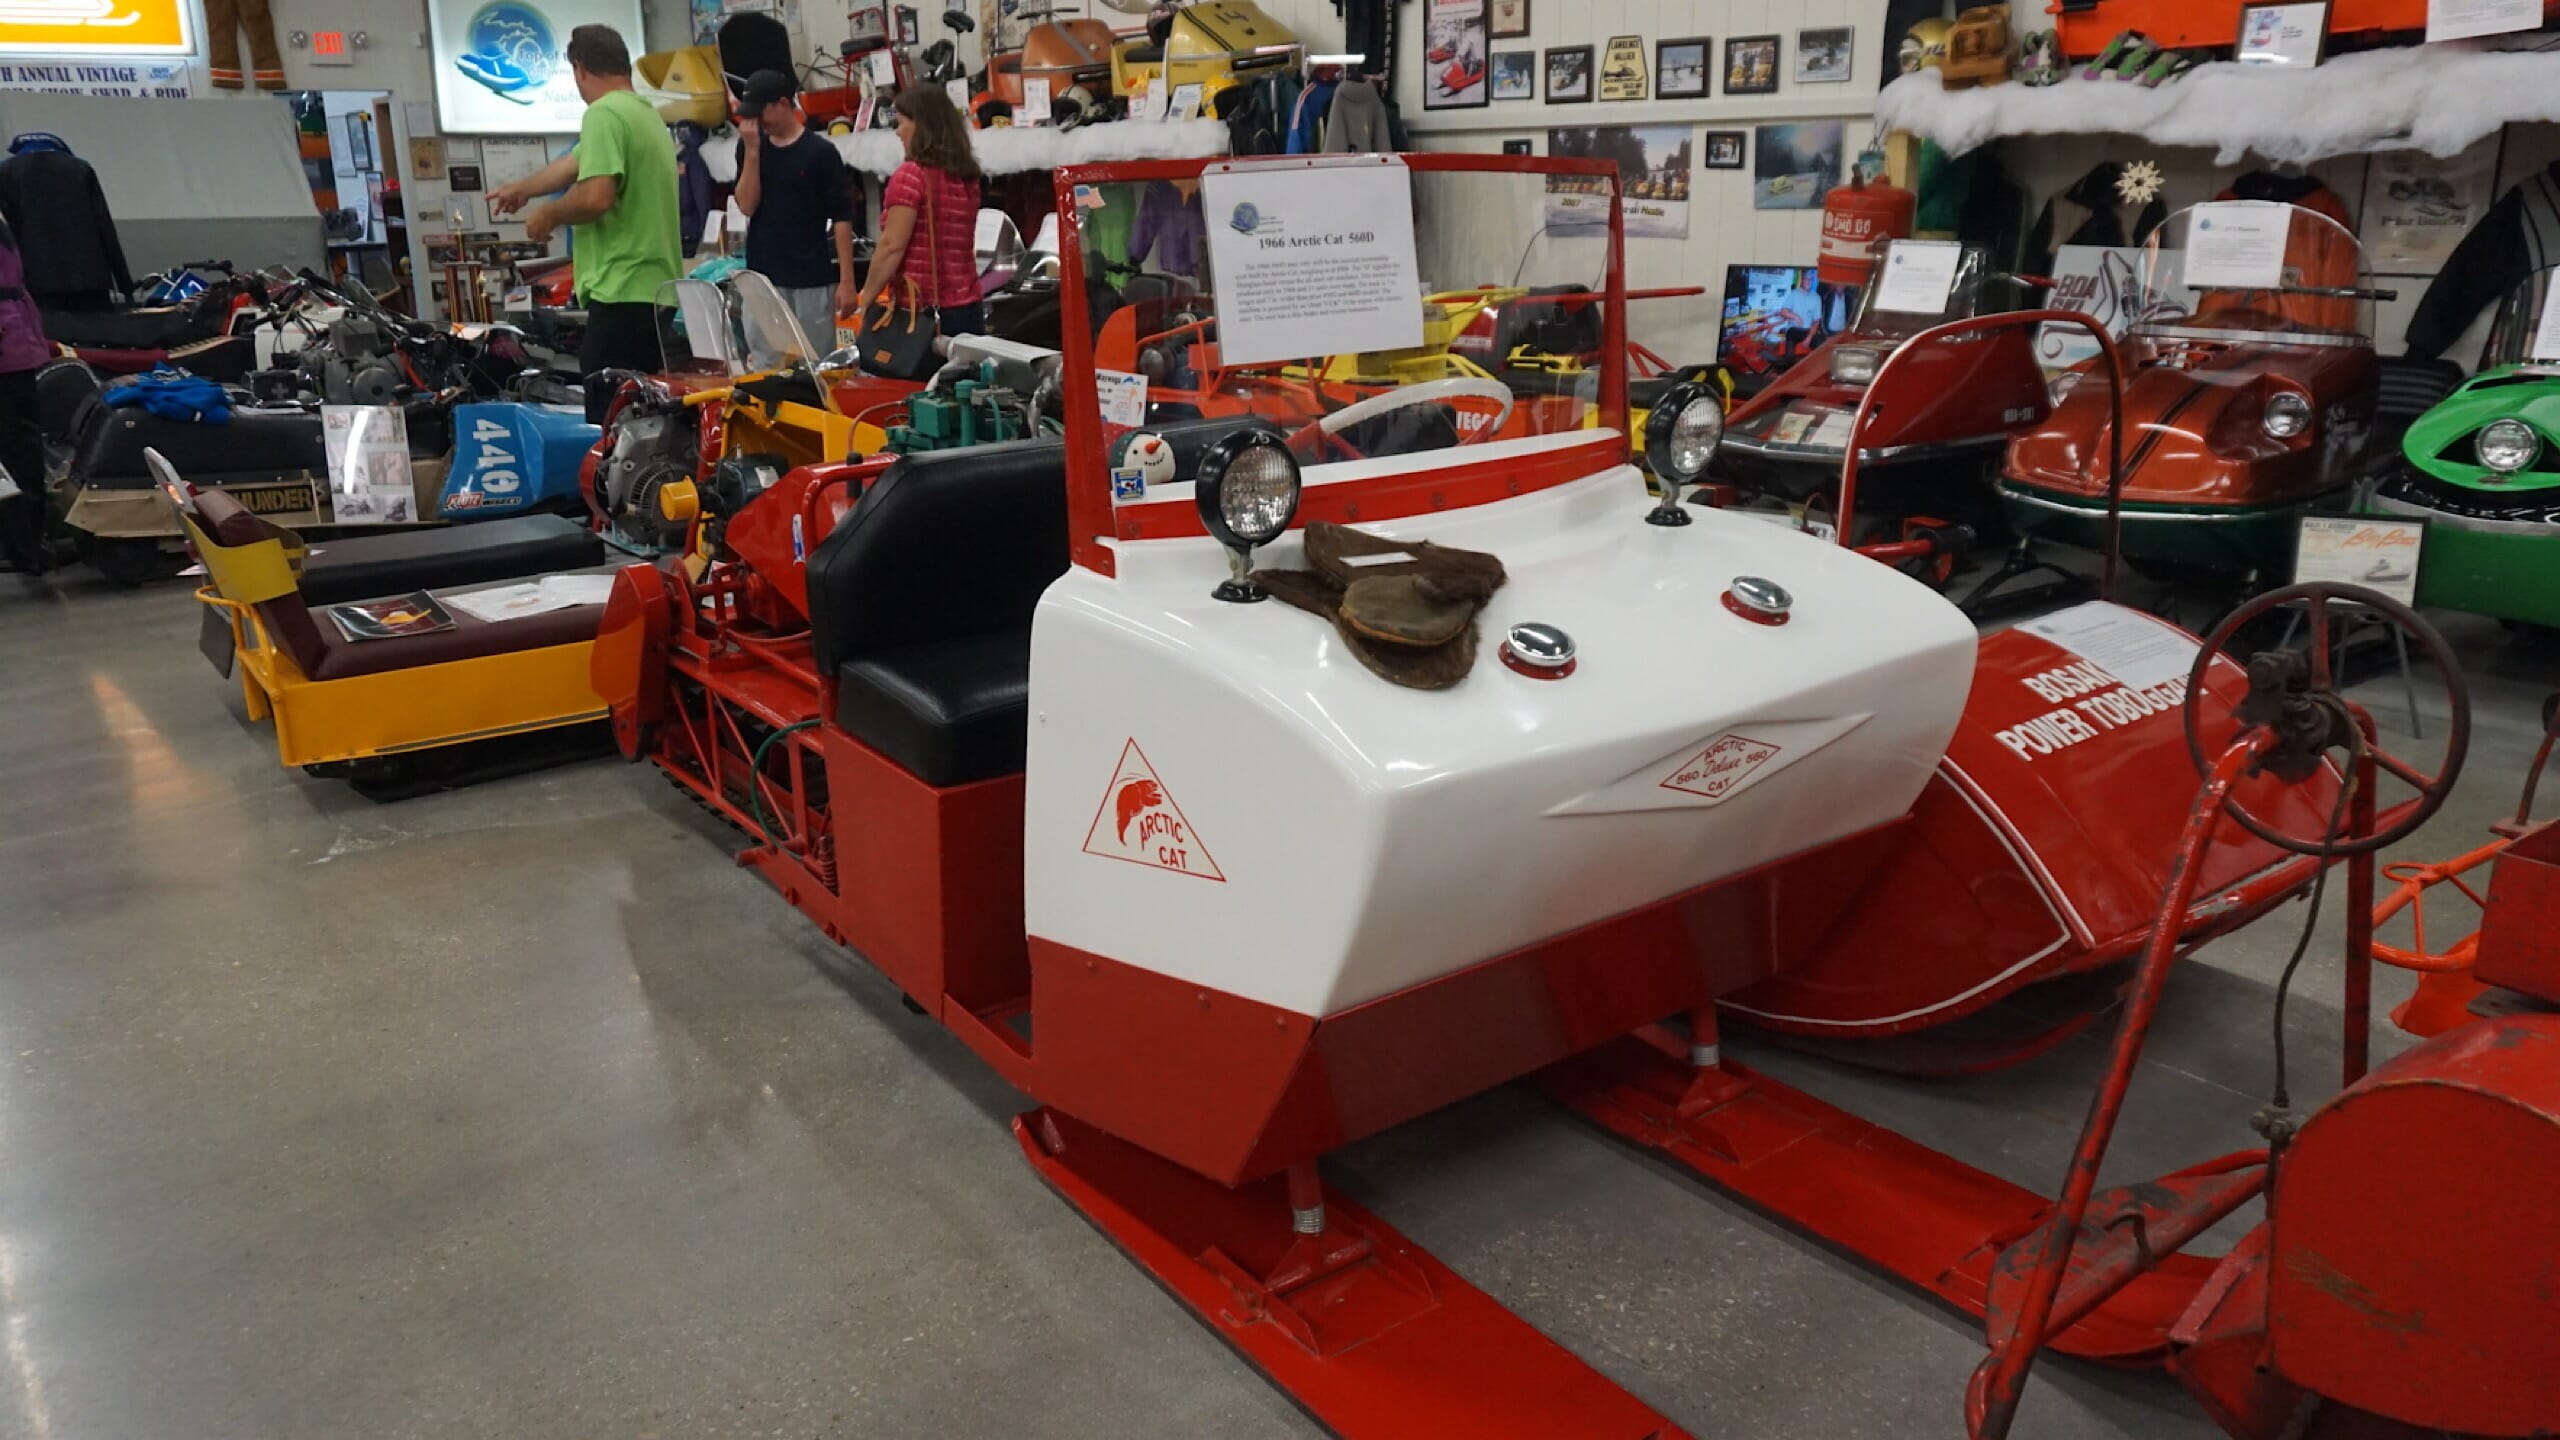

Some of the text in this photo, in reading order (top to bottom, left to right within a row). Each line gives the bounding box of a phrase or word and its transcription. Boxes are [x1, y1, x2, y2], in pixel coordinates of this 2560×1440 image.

[314, 32, 344, 54] EXIT
[18, 66, 72, 82] ANNUAL
[78, 66, 137, 82] VINTAGE
[1259, 231, 1375, 249] 1966 Arctic Cat 560D
[2056, 275, 2098, 298] BOA
[473, 419, 519, 493] 440
[2022, 659, 2119, 704] BOSAK
[1995, 708, 2099, 761] POWER
[1704, 740, 1746, 761] ARCTIC
[1708, 778, 1730, 791] CAT
[1140, 811, 1184, 851] ARCTIC
[1159, 846, 1187, 869] CAT
